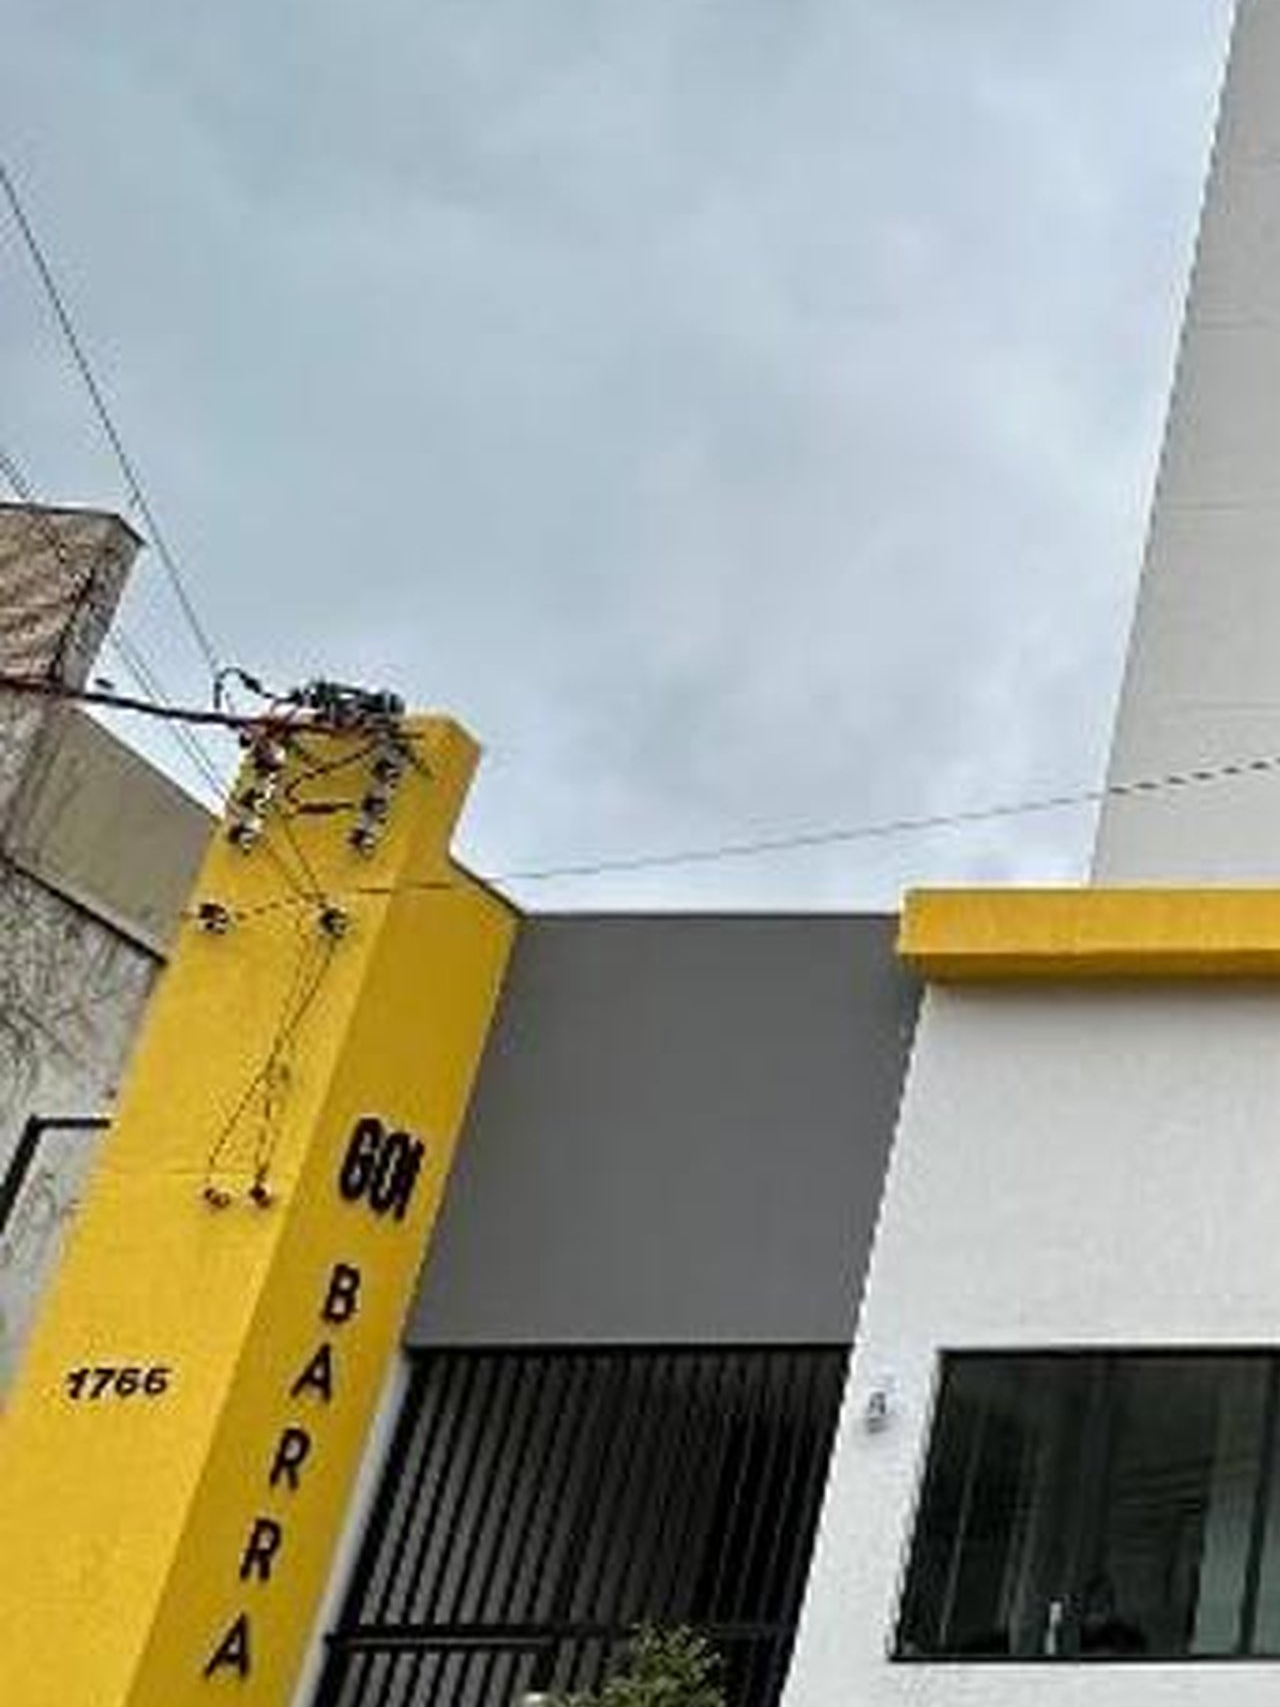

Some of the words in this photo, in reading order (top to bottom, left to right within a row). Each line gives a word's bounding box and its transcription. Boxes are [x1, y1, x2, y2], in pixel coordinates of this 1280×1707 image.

[340, 1118, 426, 1220] GO!
[67, 1367, 172, 1399] 1766
[207, 1264, 362, 1682] BARRA
